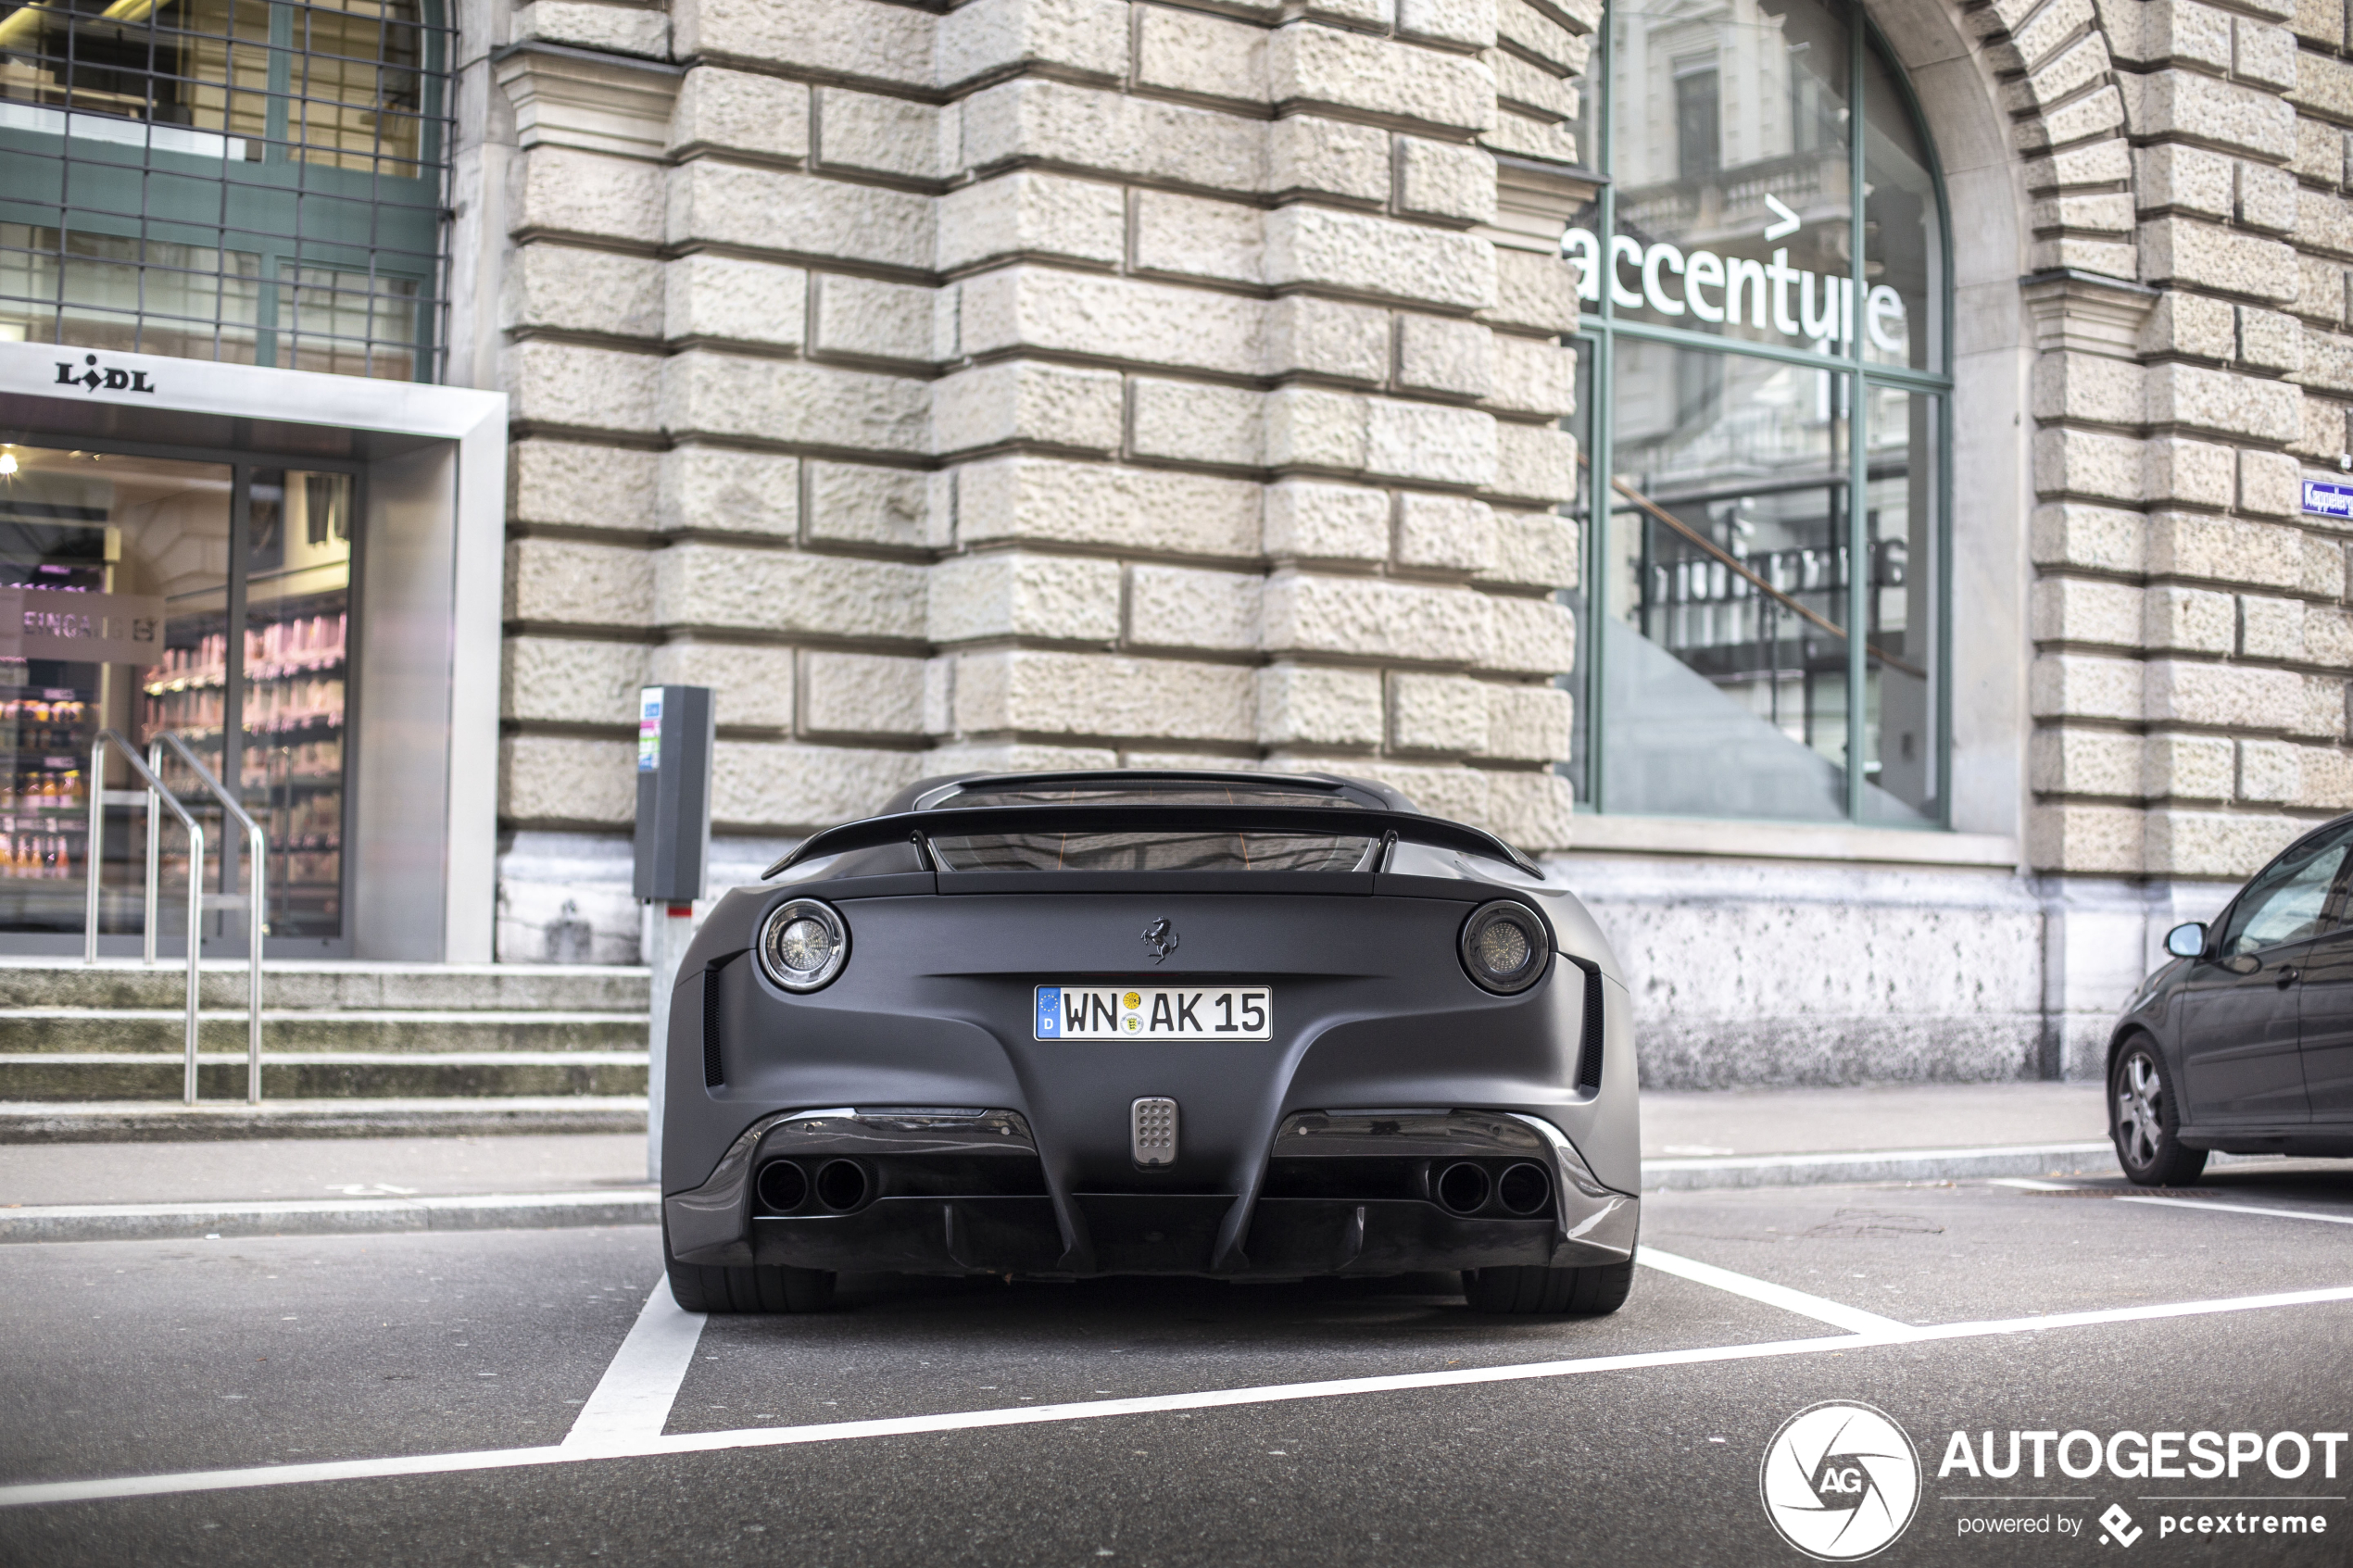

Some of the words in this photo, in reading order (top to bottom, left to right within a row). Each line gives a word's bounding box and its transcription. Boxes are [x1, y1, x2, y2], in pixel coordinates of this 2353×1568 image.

[1560, 228, 1903, 353] accenture
[1044, 1018, 1054, 1030] D
[1063, 993, 1117, 1032] WN
[1150, 993, 1203, 1032] AK
[1214, 993, 1265, 1032] 15
